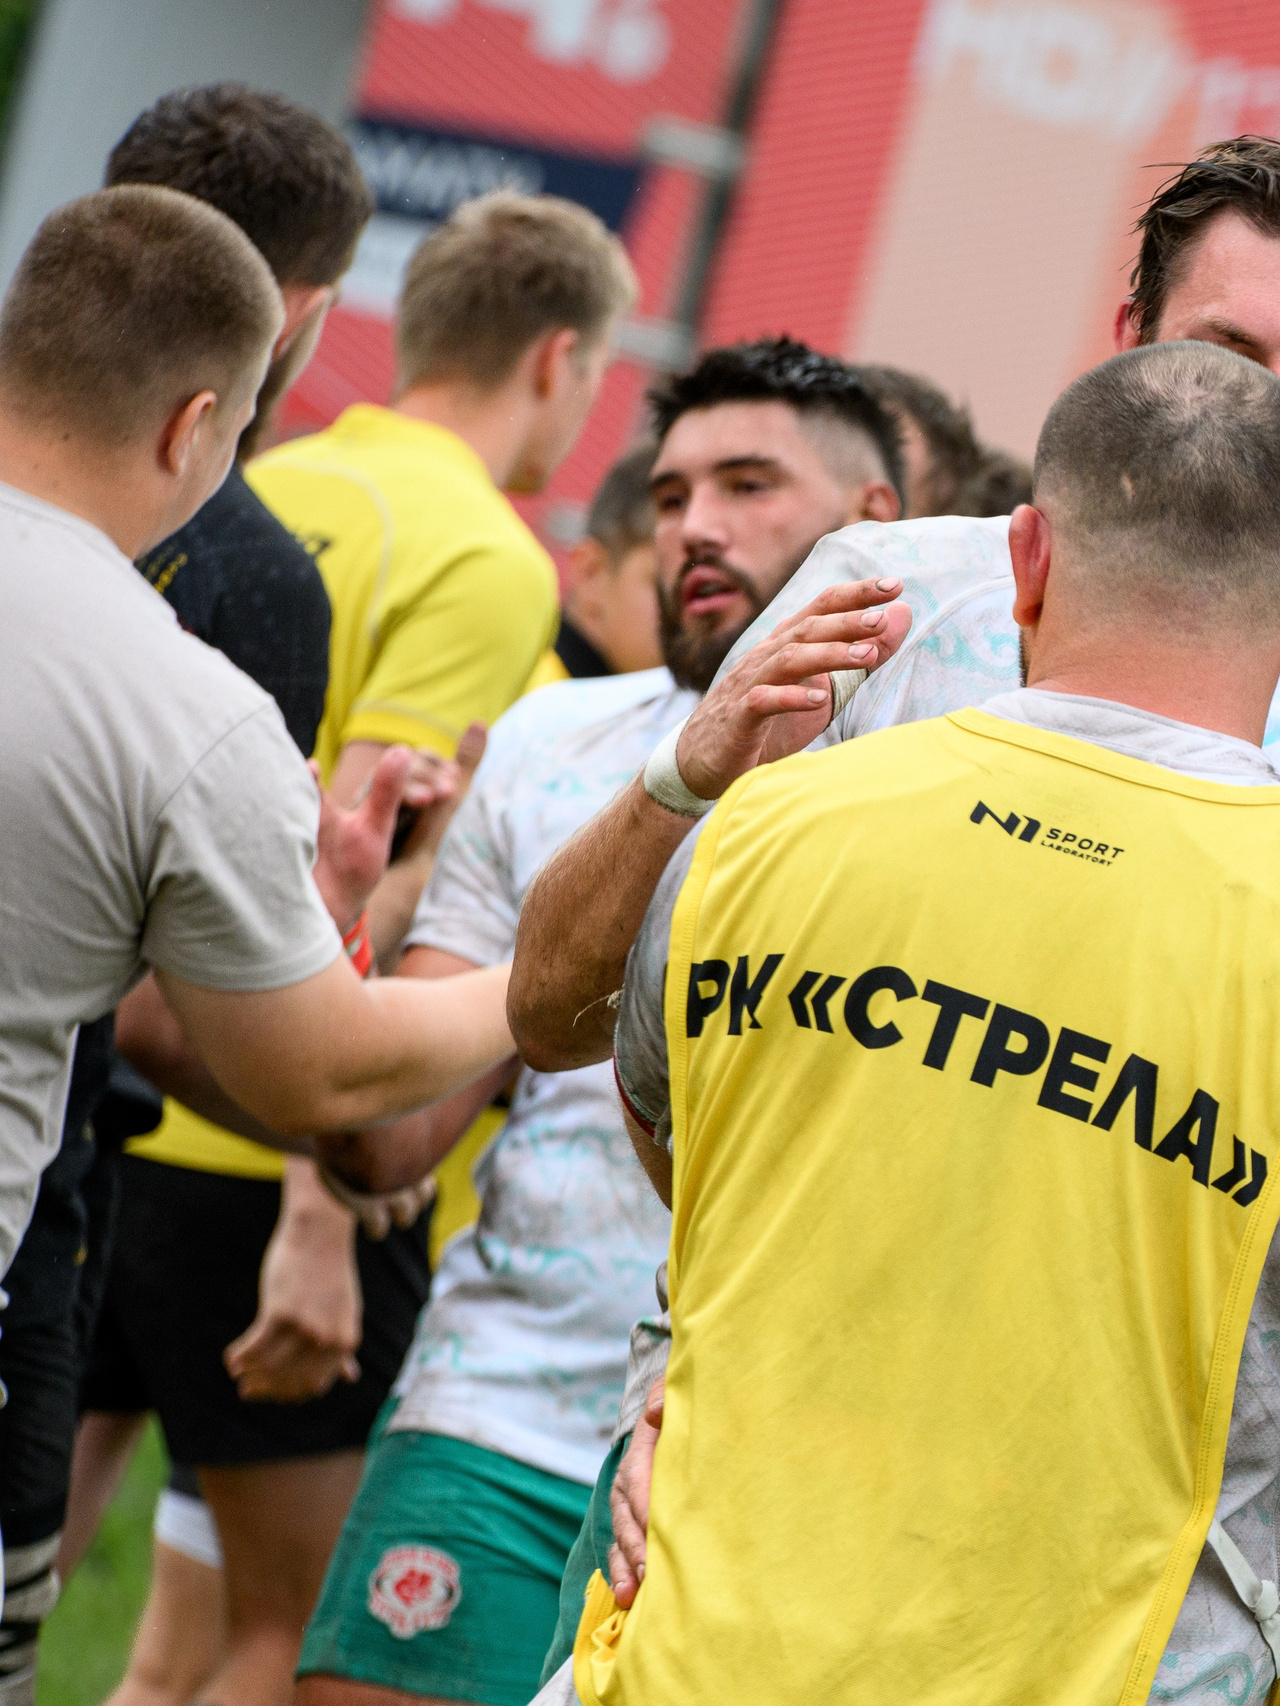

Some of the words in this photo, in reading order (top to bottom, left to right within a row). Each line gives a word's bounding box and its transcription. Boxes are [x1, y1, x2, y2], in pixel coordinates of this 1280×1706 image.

[1040, 840, 1114, 867] LABORATORY
[1046, 827, 1125, 859] SPORT
[686, 953, 785, 1039] РК
[787, 965, 1268, 1208] «СТРЕЛА»
